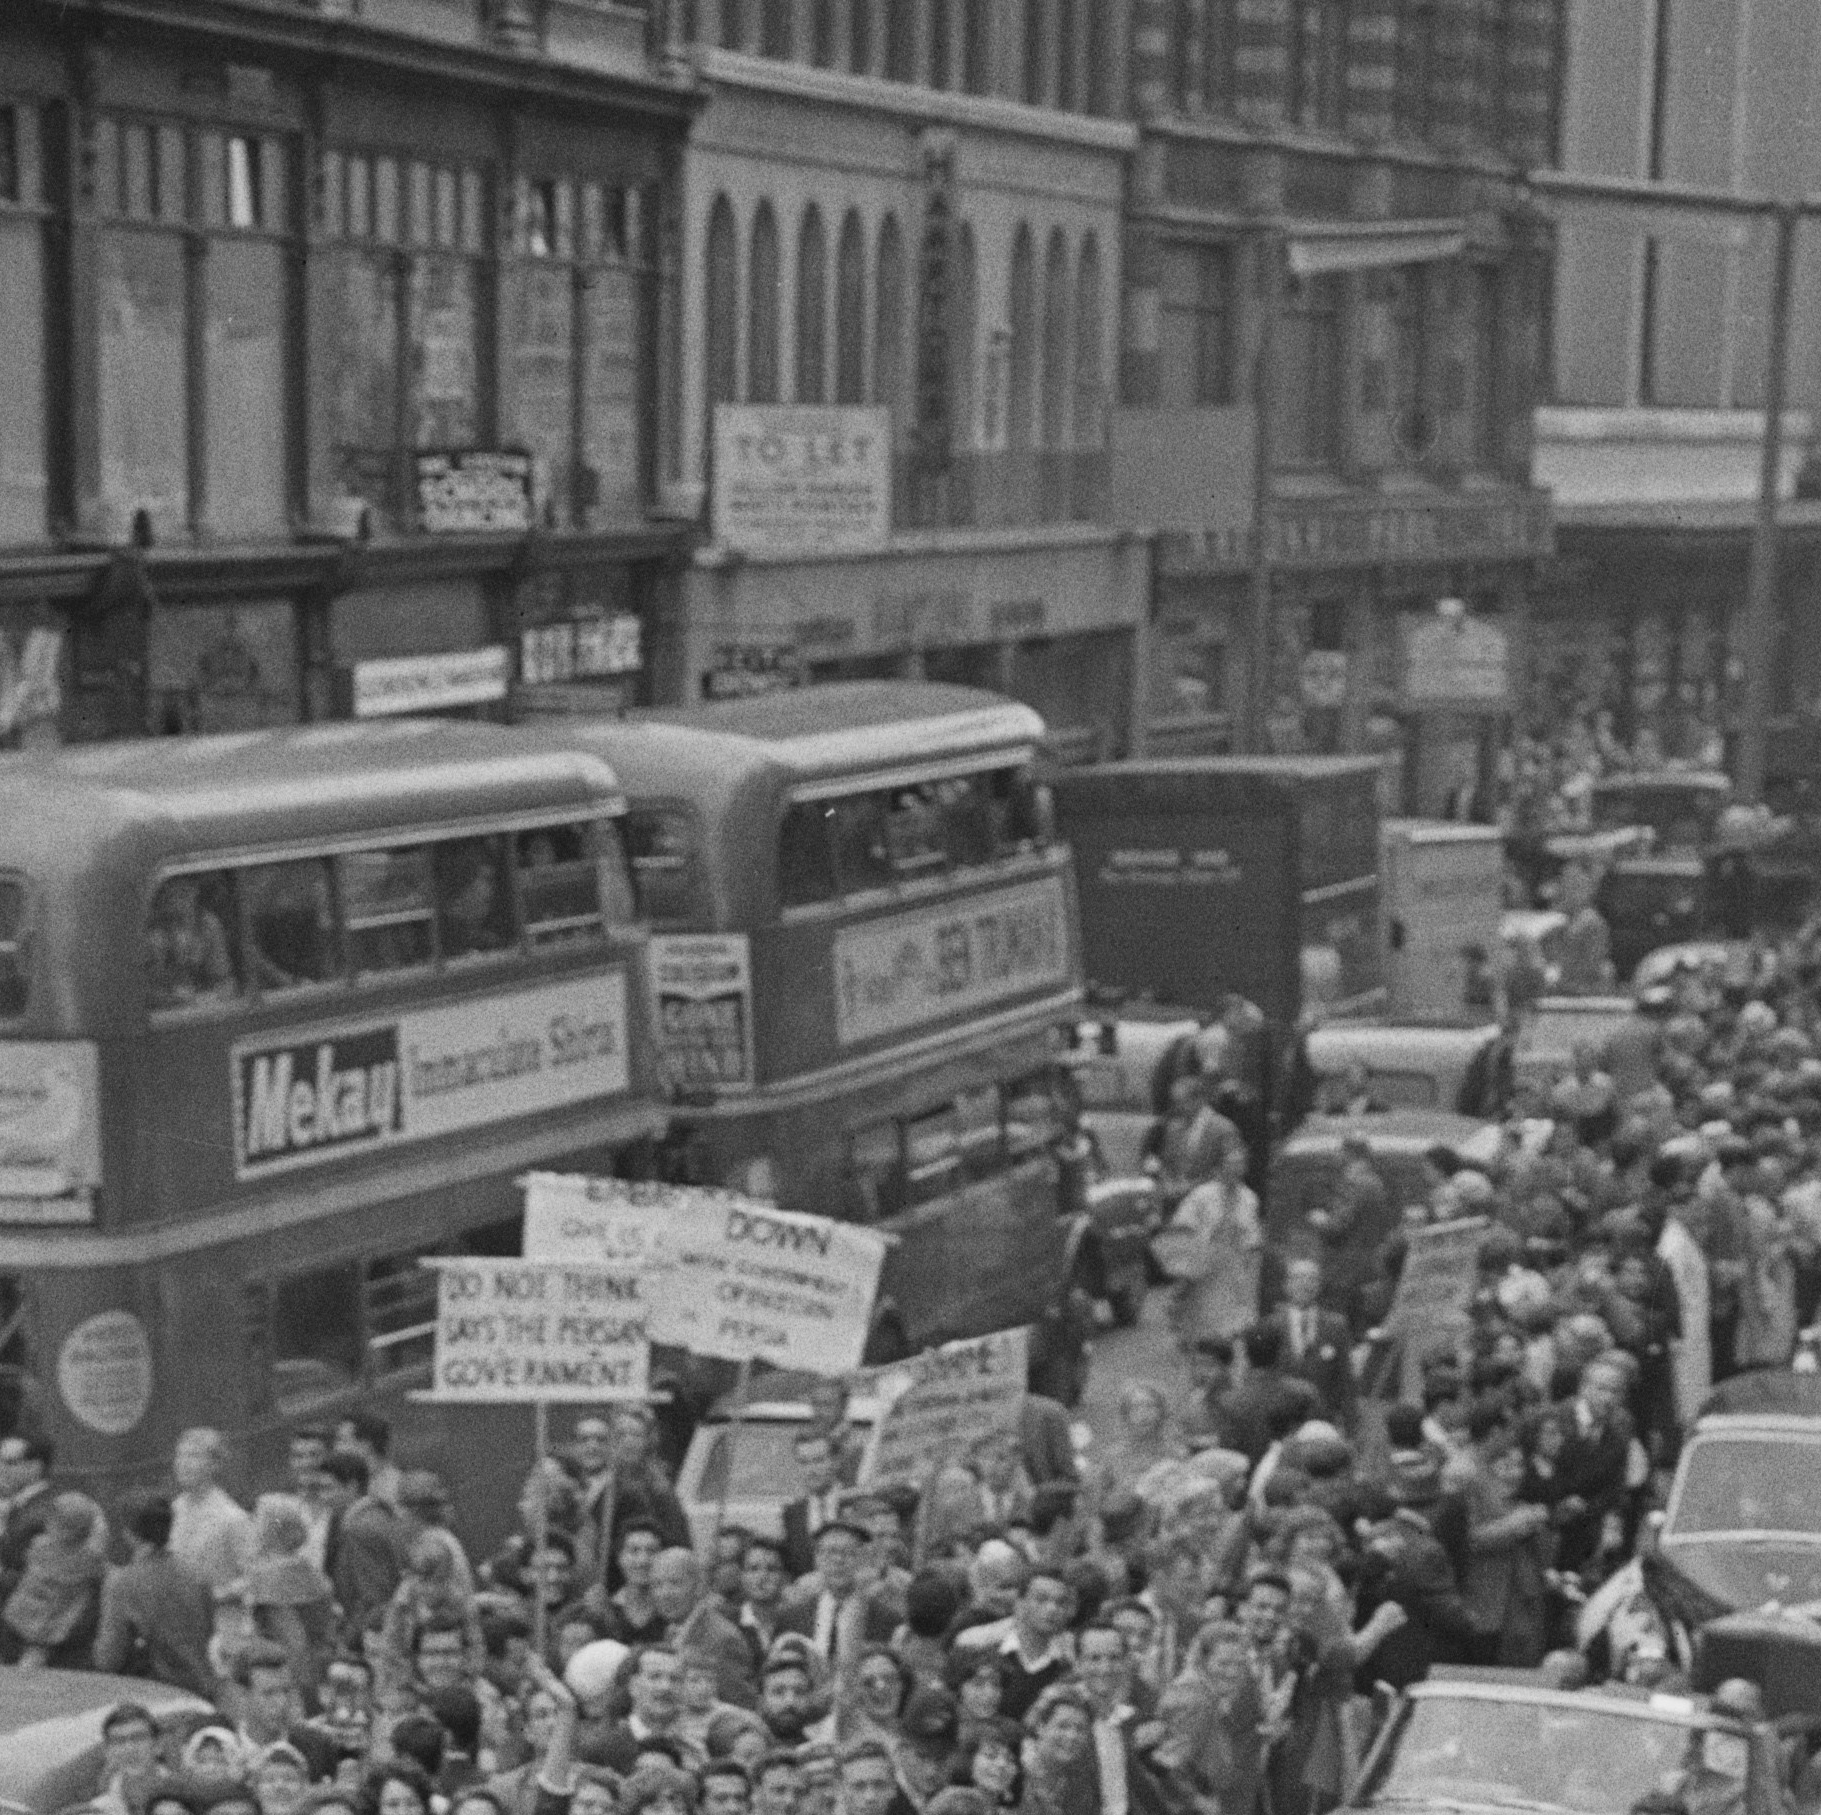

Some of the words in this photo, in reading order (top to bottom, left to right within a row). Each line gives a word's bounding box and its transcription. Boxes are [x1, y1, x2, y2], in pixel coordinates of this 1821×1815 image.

[247, 1043, 398, 1151] Mekay
[724, 1208, 832, 1257] DOWN
[493, 1271, 546, 1301] NOT
[443, 1357, 634, 1387] GOVERNMENT
